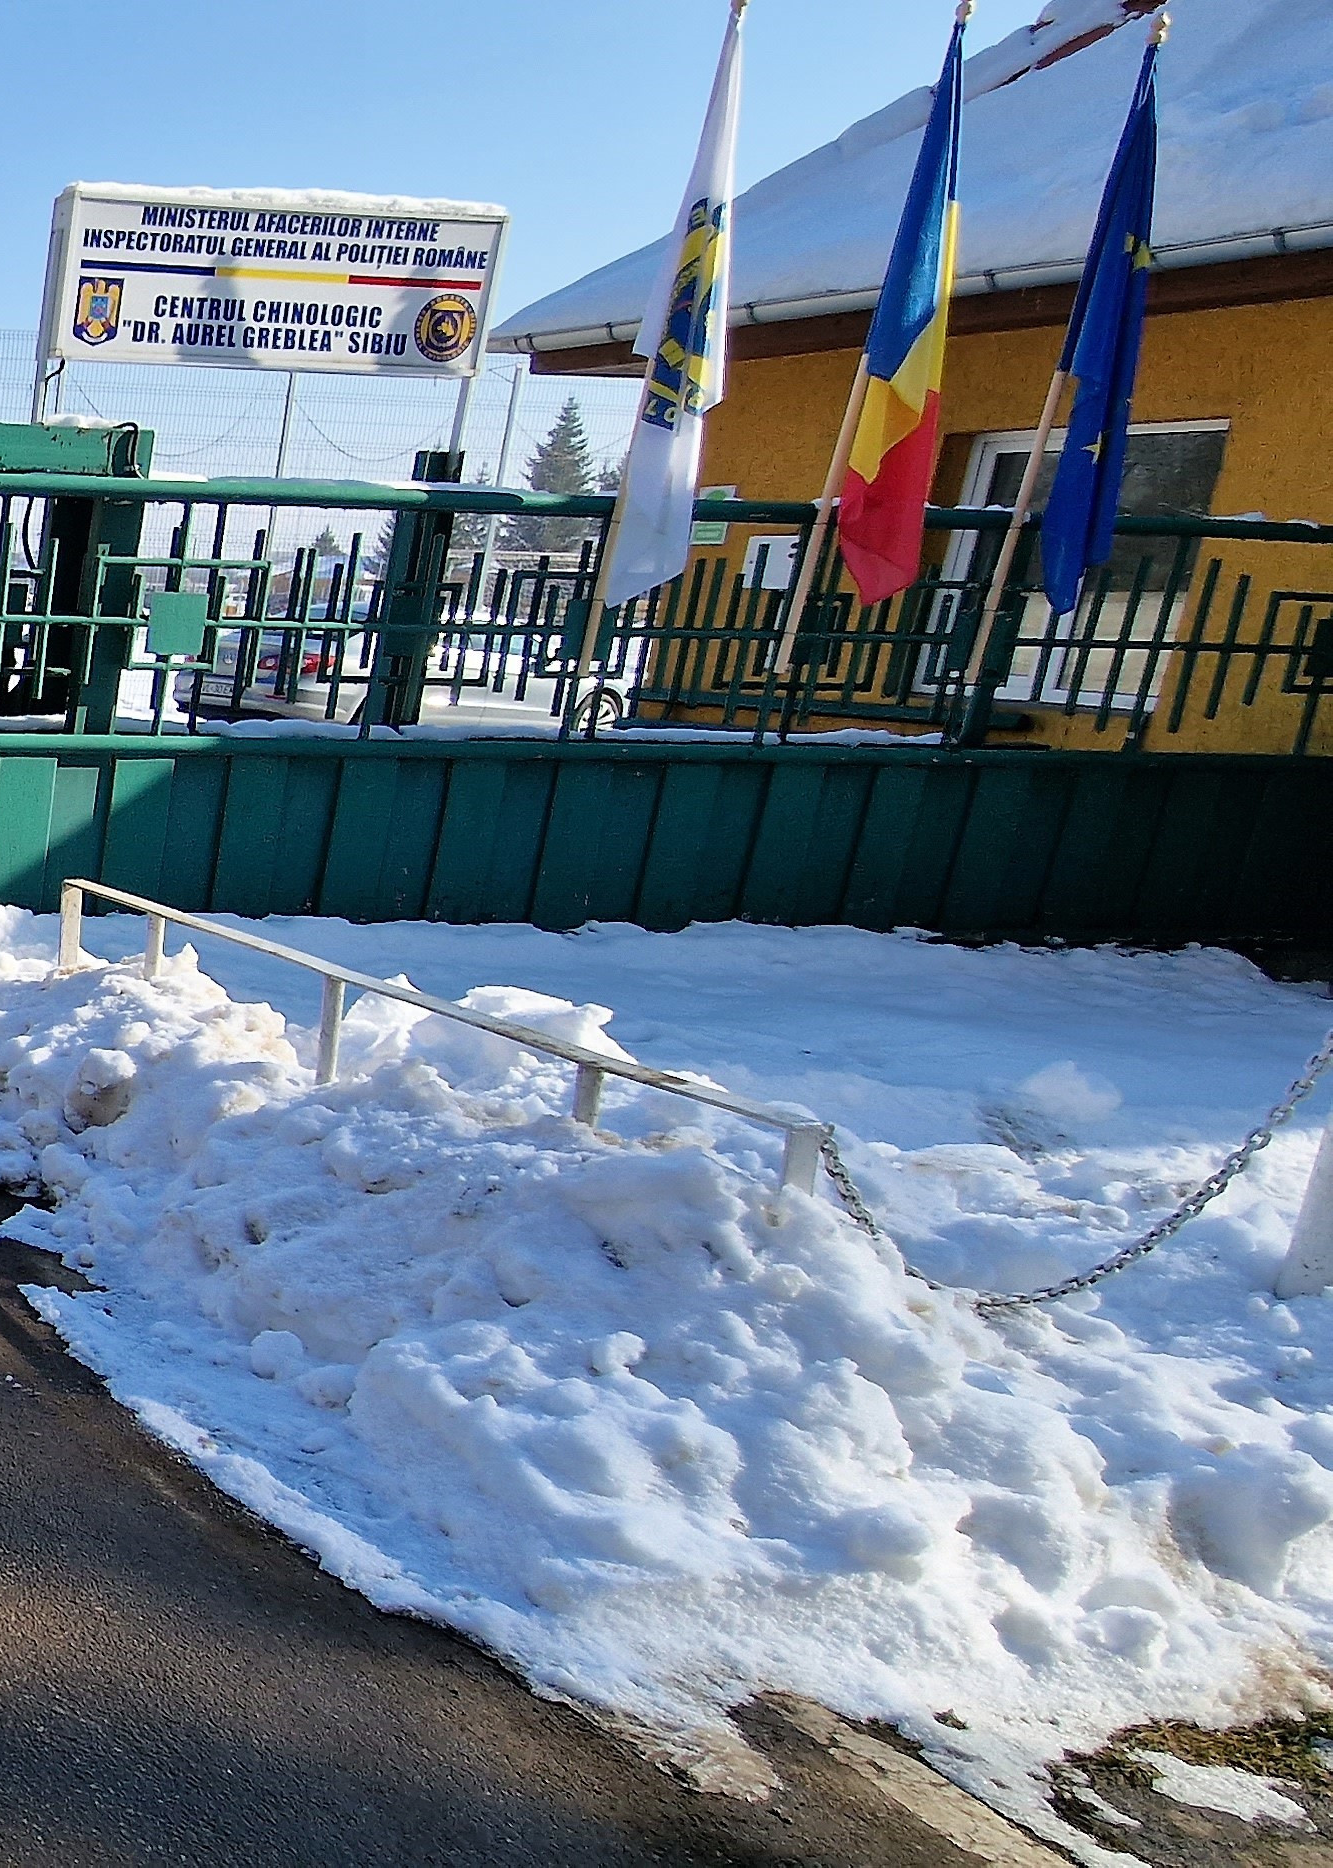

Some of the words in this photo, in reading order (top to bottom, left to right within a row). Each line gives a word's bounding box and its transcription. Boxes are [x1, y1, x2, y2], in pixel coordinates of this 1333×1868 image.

[141, 206, 250, 231] MINISTERUL
[254, 213, 362, 238] AFACERILOR
[365, 219, 440, 242] INTERNE
[82, 228, 227, 256] INSPECTORATUL
[230, 237, 307, 260] GENERAL
[311, 242, 331, 262] AL
[335, 243, 409, 269] POLIȚIEI
[411, 246, 489, 270] ROMÂNE
[153, 294, 247, 322] CENTRUL
[252, 300, 383, 328] CHINOLOGIC
[122, 319, 166, 344] "DR.
[171, 322, 237, 348] AUREL
[242, 326, 344, 352] GREBLEA"
[348, 331, 408, 356] SIBIU
